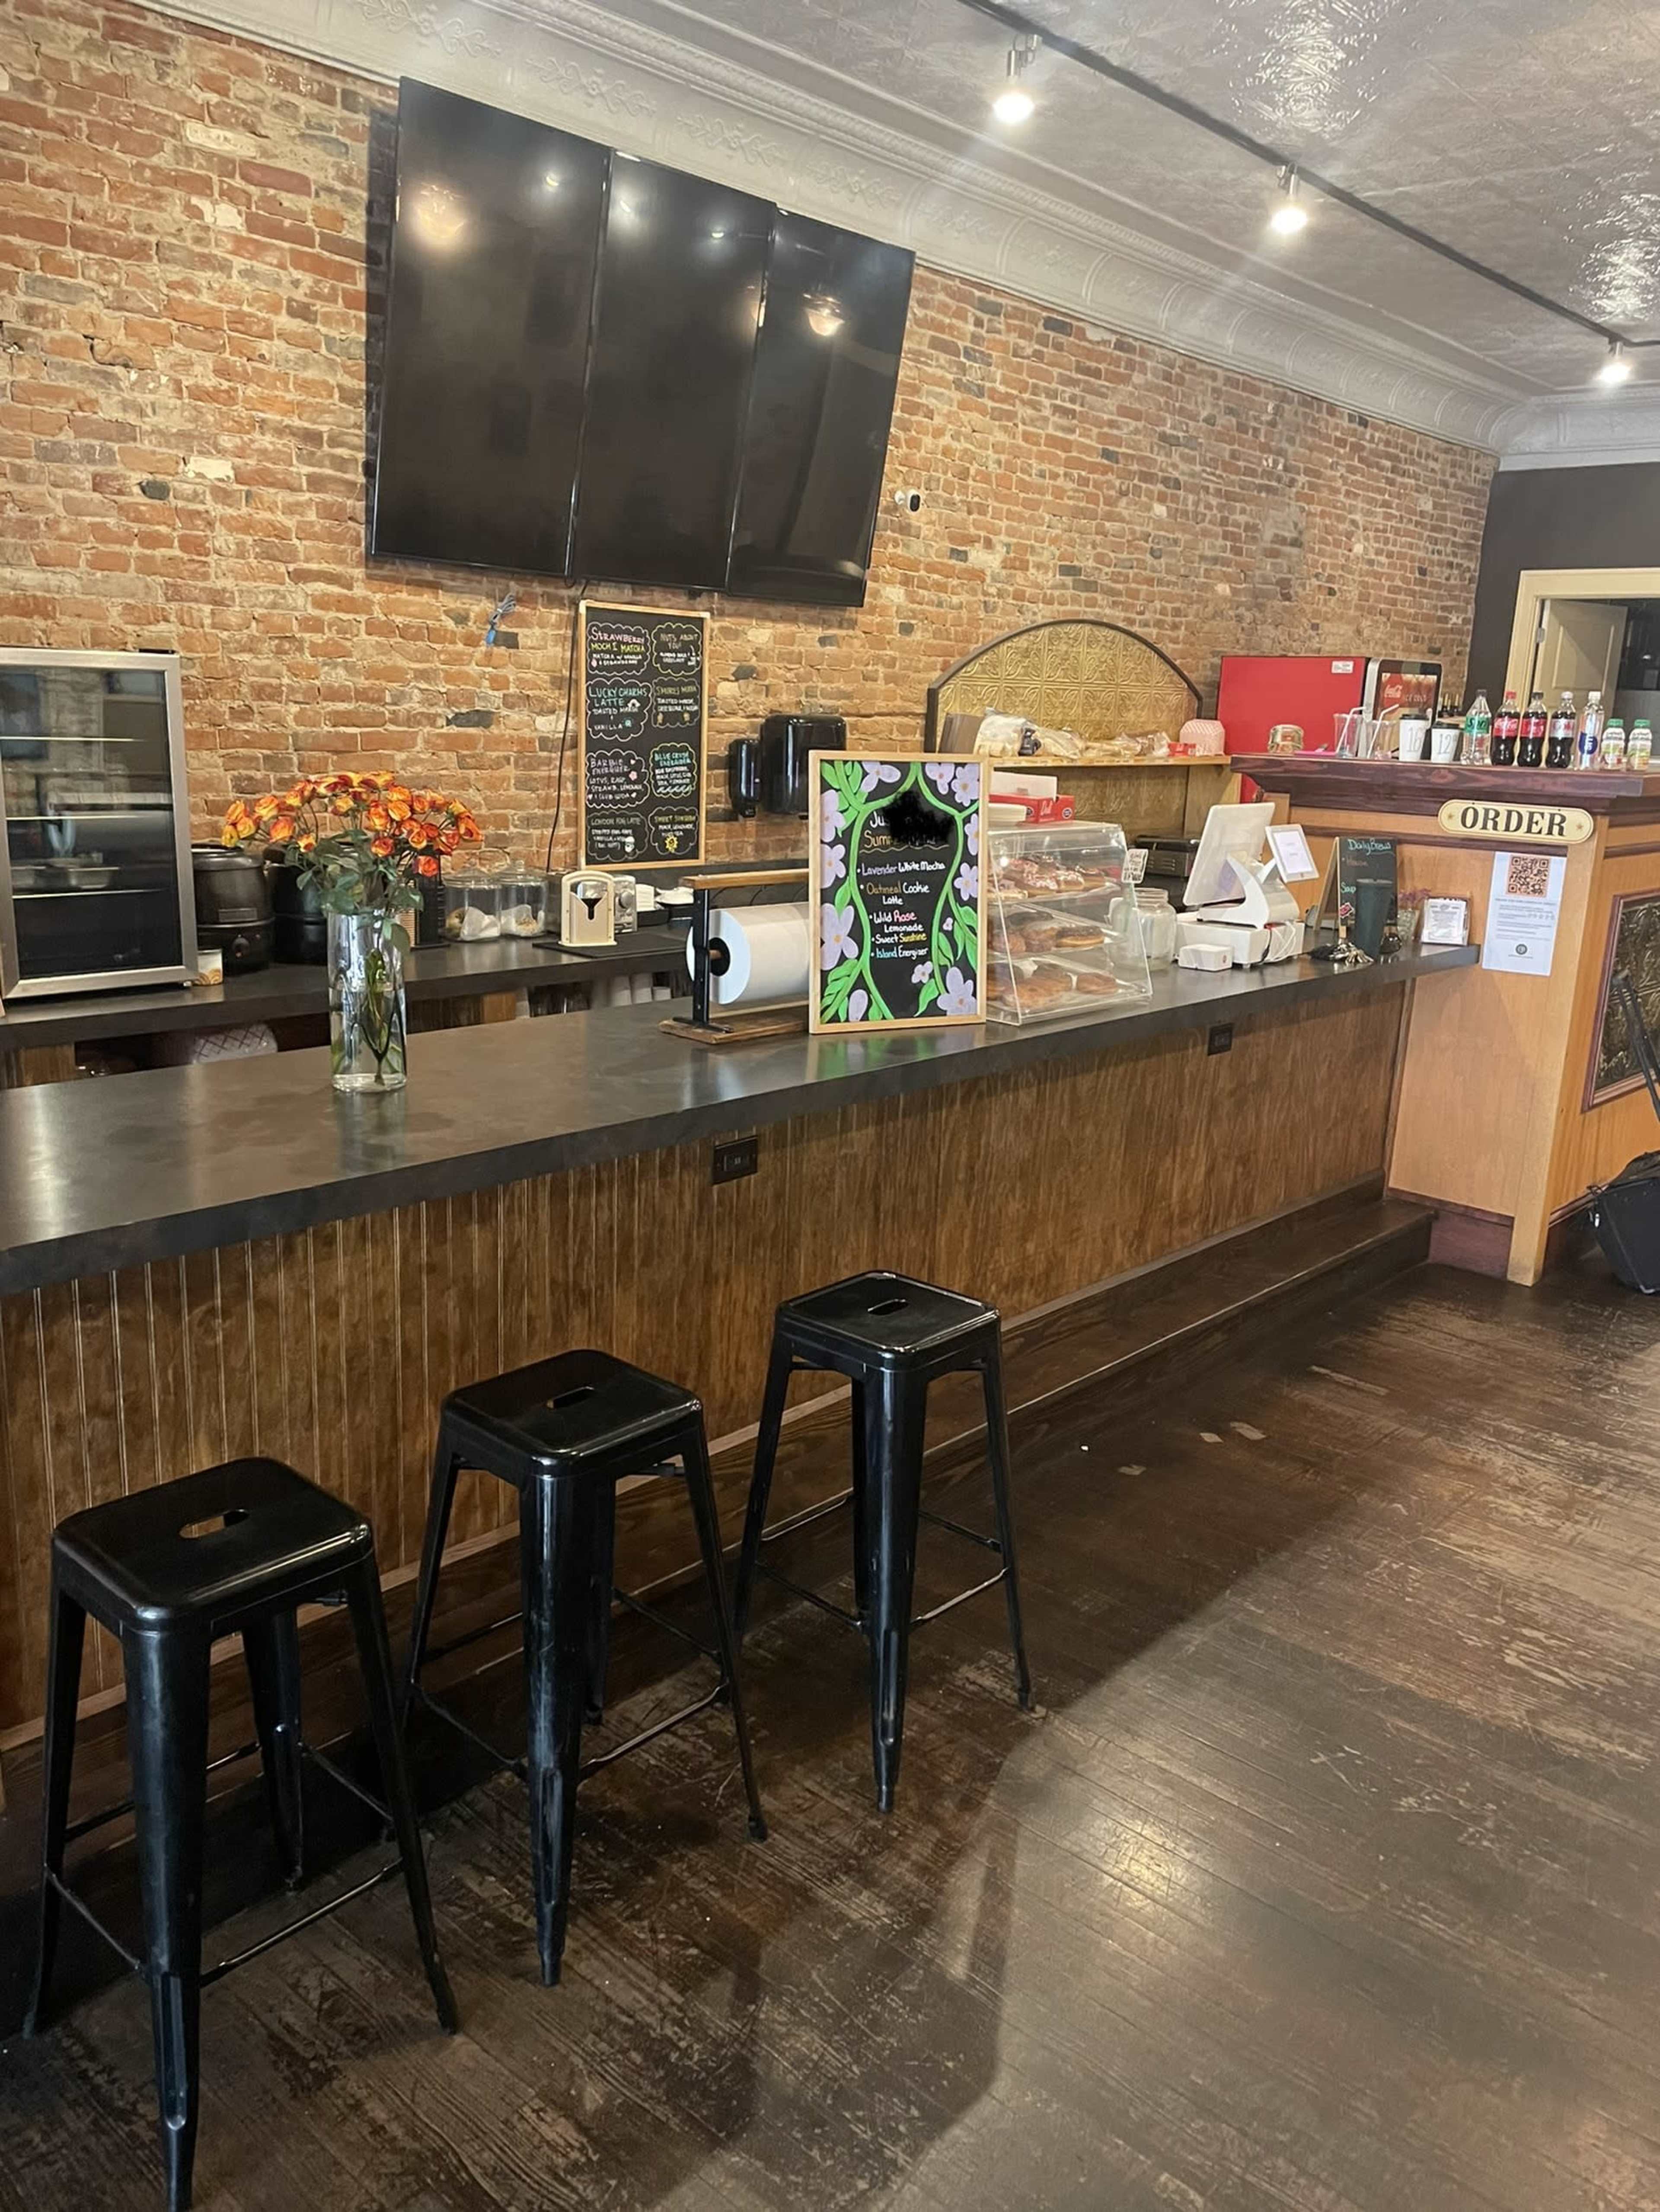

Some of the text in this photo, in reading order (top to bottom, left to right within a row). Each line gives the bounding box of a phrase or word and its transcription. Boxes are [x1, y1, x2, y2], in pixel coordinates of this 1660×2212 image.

[588, 686, 648, 698] LUCKY CHARMS
[594, 698, 624, 707] LATTE
[1407, 725, 1422, 753] 16
[1437, 733, 1453, 755] 12
[1460, 806, 1567, 837] ORDER
[1347, 838, 1371, 855] Daily
[862, 861, 946, 876] Lavender White Mocha
[866, 880, 930, 895] Oatmeal Cookie
[1341, 881, 1357, 894] Soup
[882, 895, 903, 905] Latte
[873, 910, 917, 924] Wild Rose
[884, 923, 924, 933] Lemonade
[875, 932, 928, 944] Sweet Sunshine
[875, 945, 929, 960] Island Energizer
